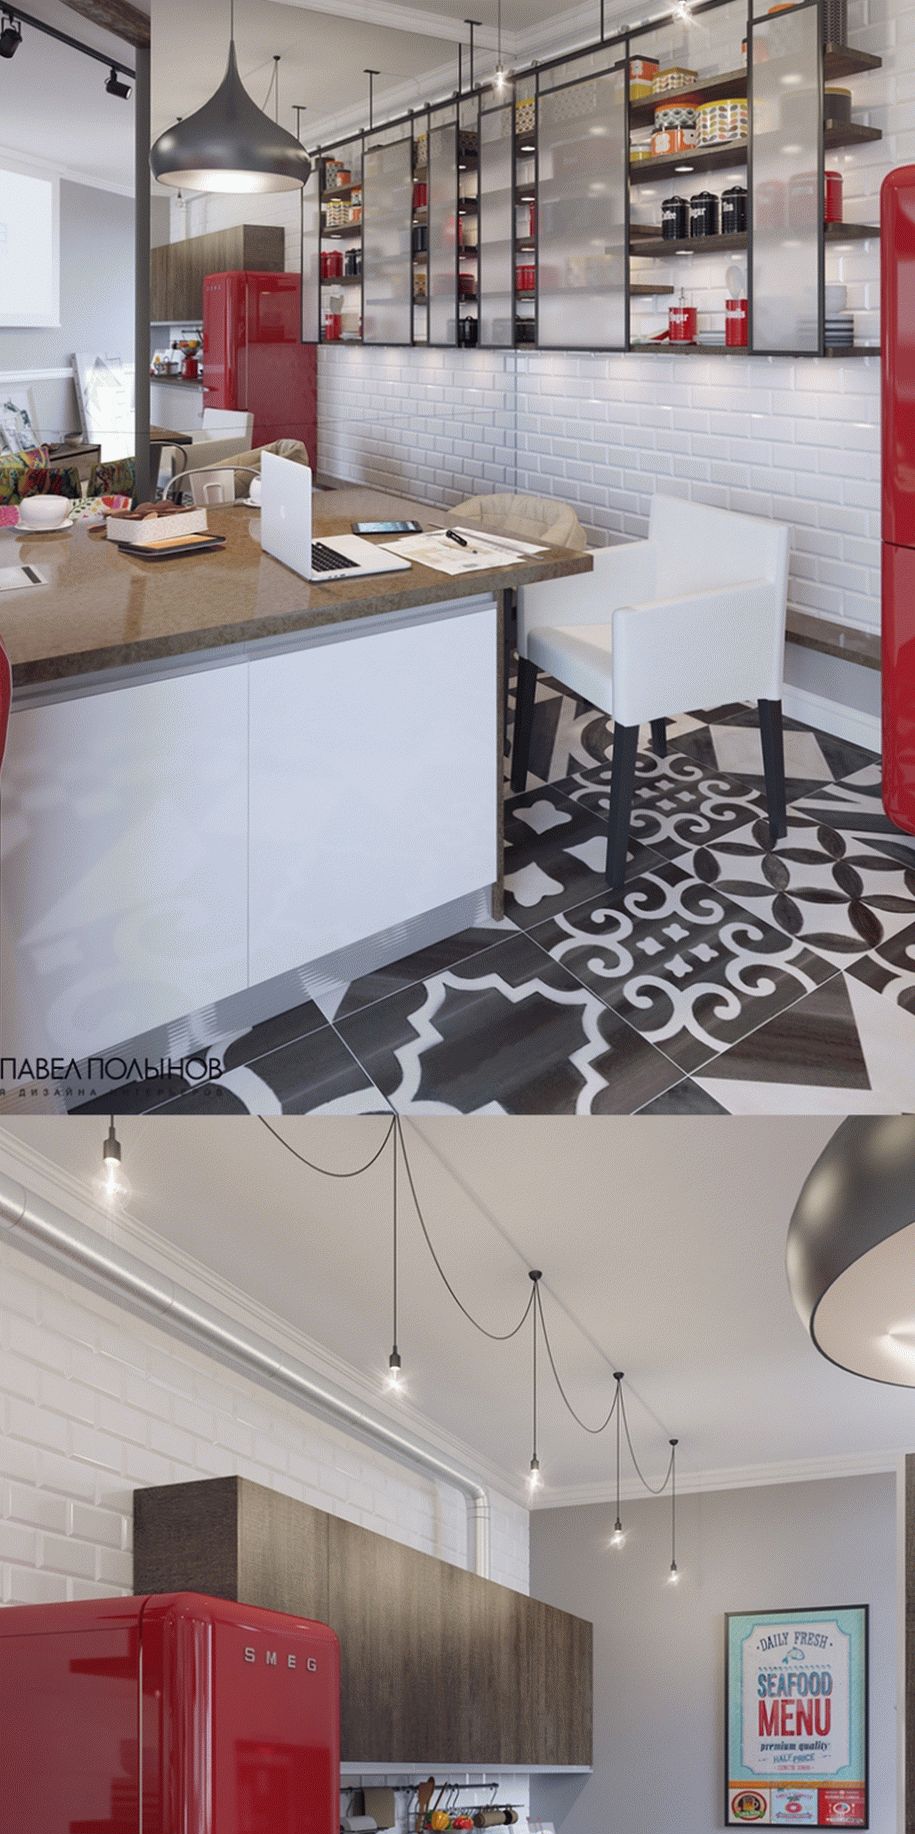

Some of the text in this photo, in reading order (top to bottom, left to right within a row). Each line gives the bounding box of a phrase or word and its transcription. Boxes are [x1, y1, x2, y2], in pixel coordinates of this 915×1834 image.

[760, 1631, 828, 1651] DAILY FRESH
[245, 1647, 317, 1672] SMEG
[757, 1671, 833, 1698] SEAFOOD
[758, 1698, 832, 1737] MENU
[760, 1740, 828, 1752] premium quality
